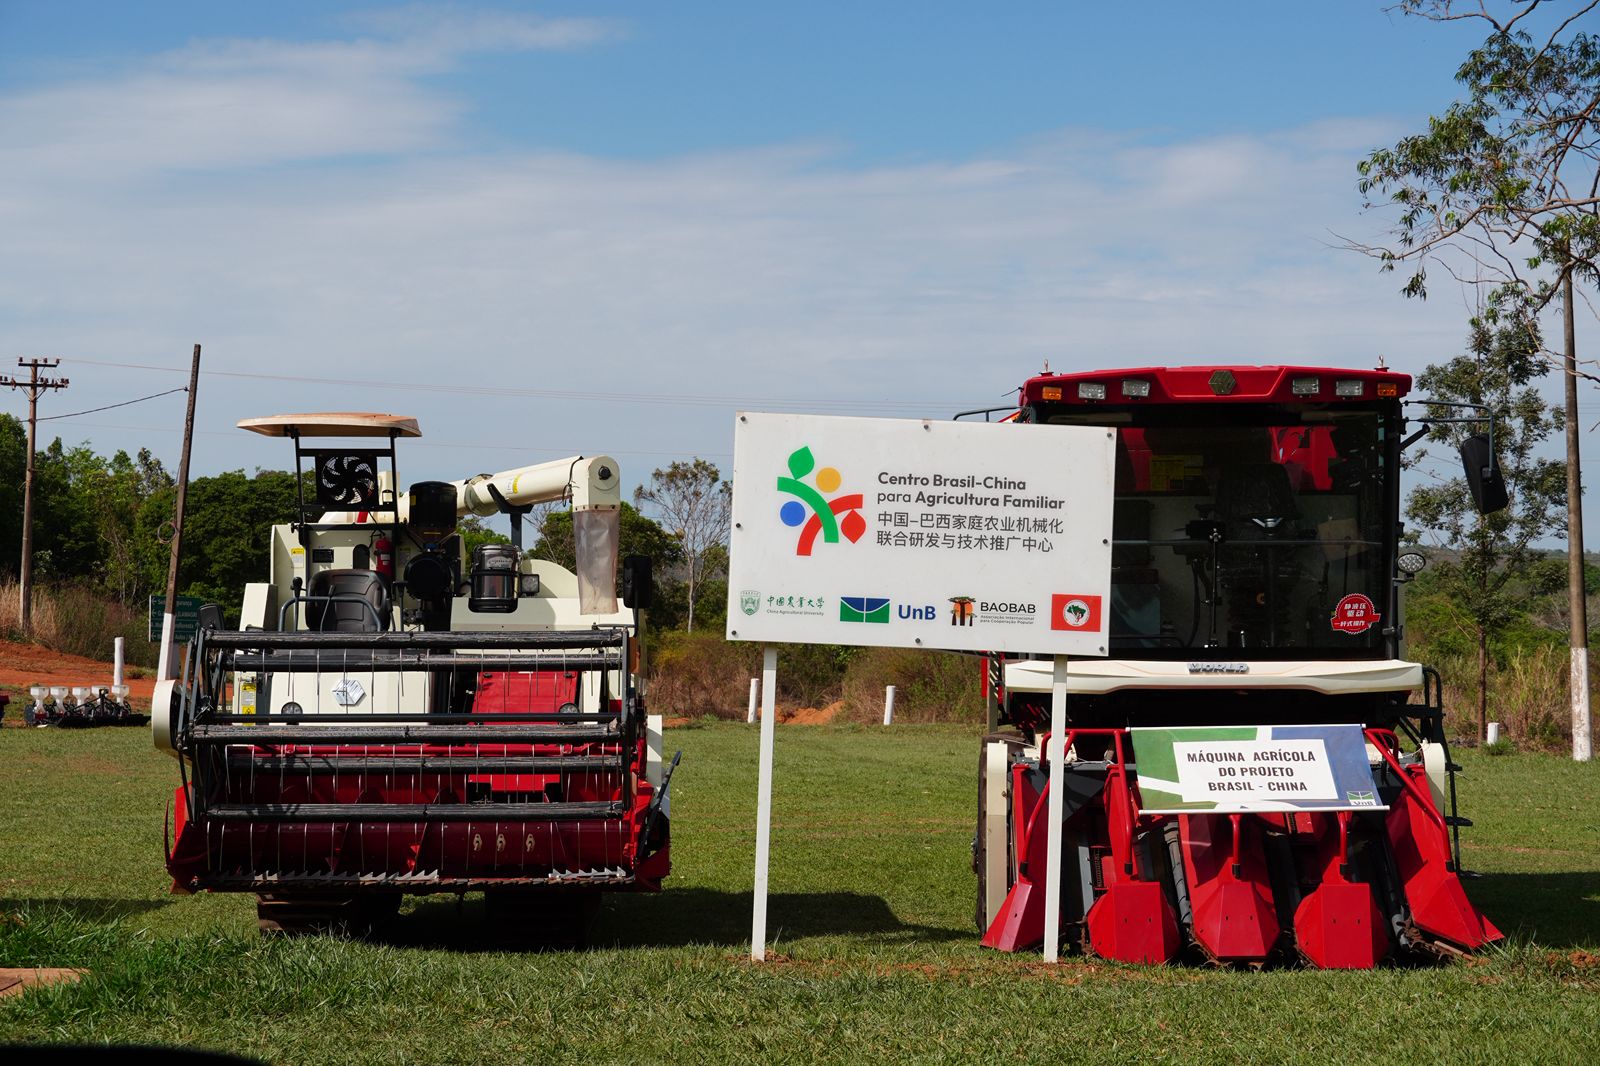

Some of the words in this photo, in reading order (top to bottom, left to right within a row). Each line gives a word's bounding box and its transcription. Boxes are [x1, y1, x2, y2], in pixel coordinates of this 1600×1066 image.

[877, 472, 930, 486] Centro
[933, 474, 1026, 490] Brasil-China
[877, 492, 912, 504] para
[915, 491, 1000, 507] Agricultura
[1003, 495, 1066, 509] Familiar
[876, 530, 1054, 553] 联合研发与技术推广中心
[898, 604, 936, 620] UnB
[980, 602, 1036, 613] BAOBAB
[1187, 749, 1246, 763] MÁQUINA
[1253, 748, 1316, 762] AGRÍCOLA
[1218, 766, 1237, 777] DO
[1240, 766, 1294, 777] PROJETO
[1208, 782, 1255, 791] BRASIL
[1267, 781, 1308, 791] CHINA
